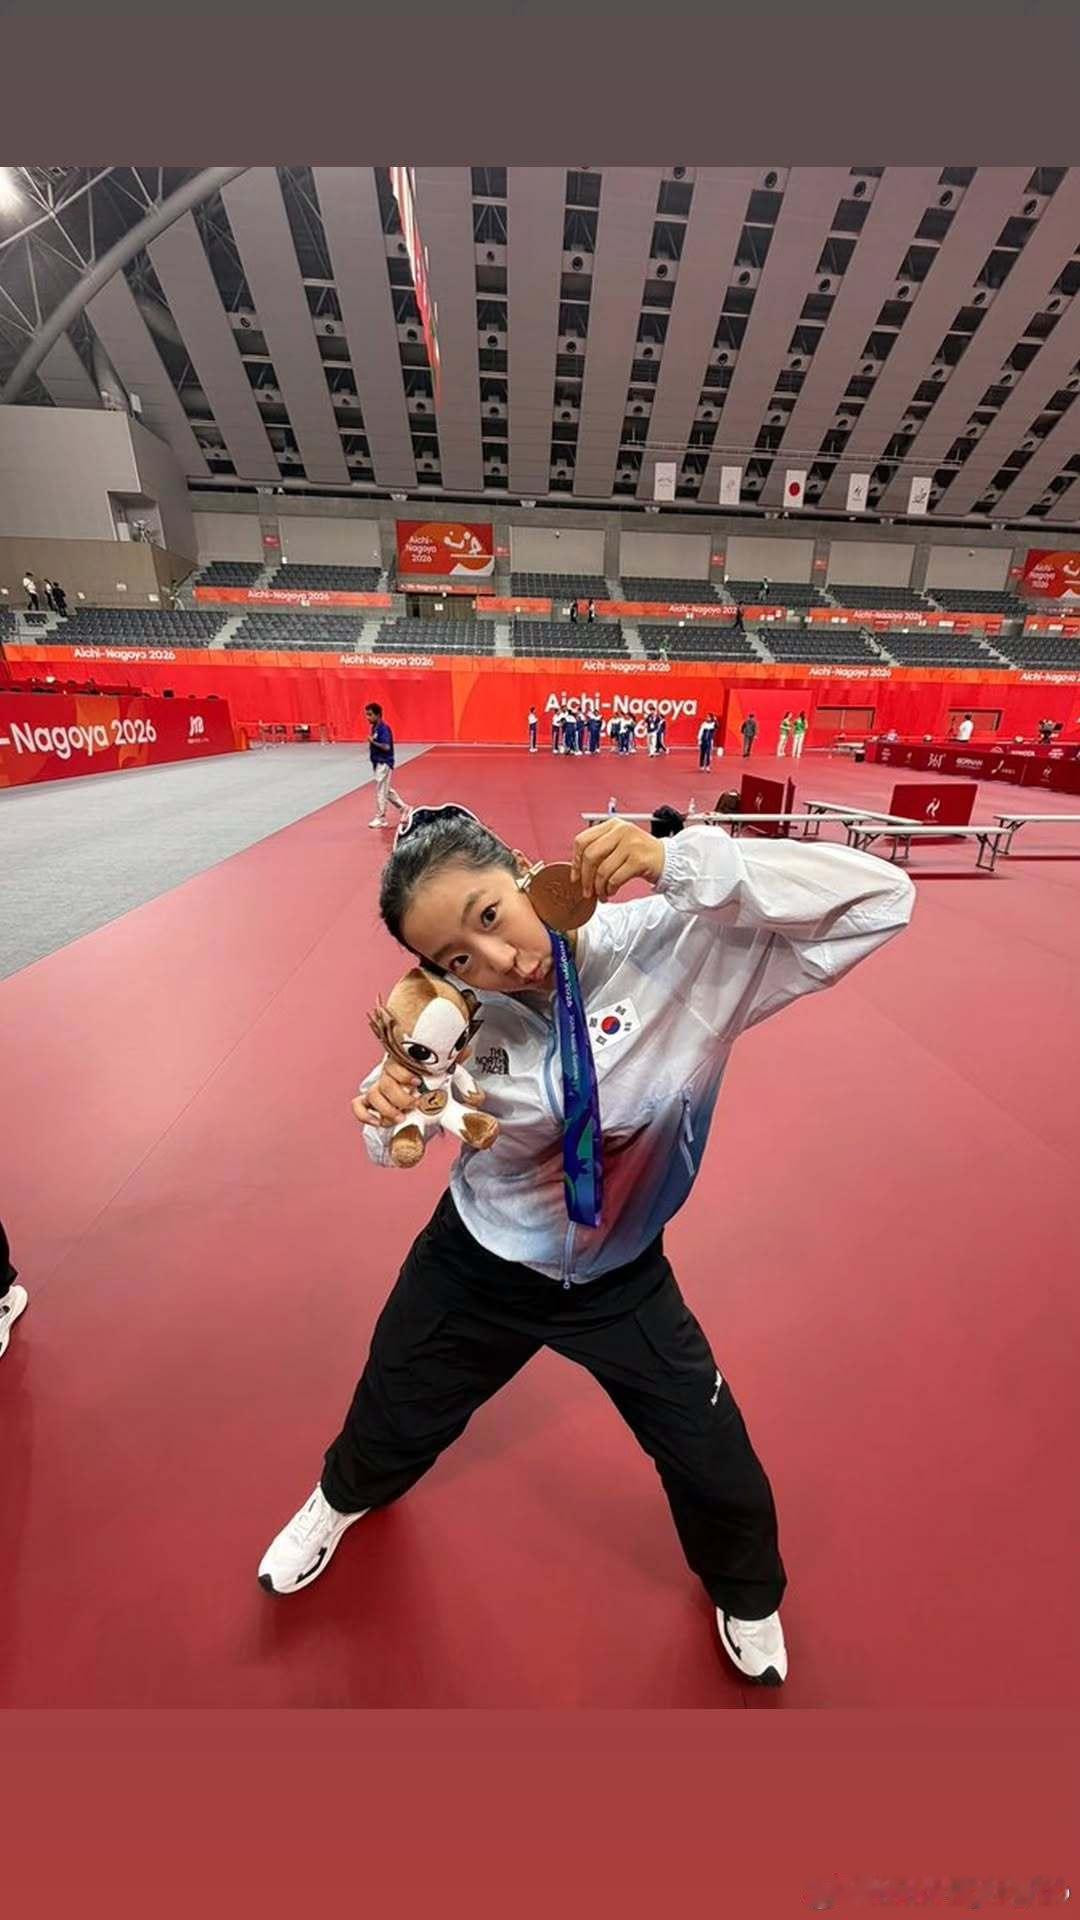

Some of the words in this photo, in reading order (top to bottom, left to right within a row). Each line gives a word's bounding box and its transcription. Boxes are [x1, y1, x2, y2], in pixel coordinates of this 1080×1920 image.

[410, 536, 432, 544] Aichi-
[405, 545, 437, 554] Nagoya
[248, 589, 306, 601] Aichi-Nagoya
[723, 606, 737, 614] 202
[74, 647, 147, 661] Aichi-Nagoya
[149, 649, 176, 660] 2026
[340, 654, 407, 667] Aichi-Nagoya
[408, 656, 434, 667] 2026
[582, 661, 646, 673] Aichi-Nagoya
[648, 662, 671, 672] 2026
[809, 667, 868, 678] Aichi-Nagoya
[545, 691, 698, 720] Aichi-Nagoya
[112, 719, 157, 745] 2026
